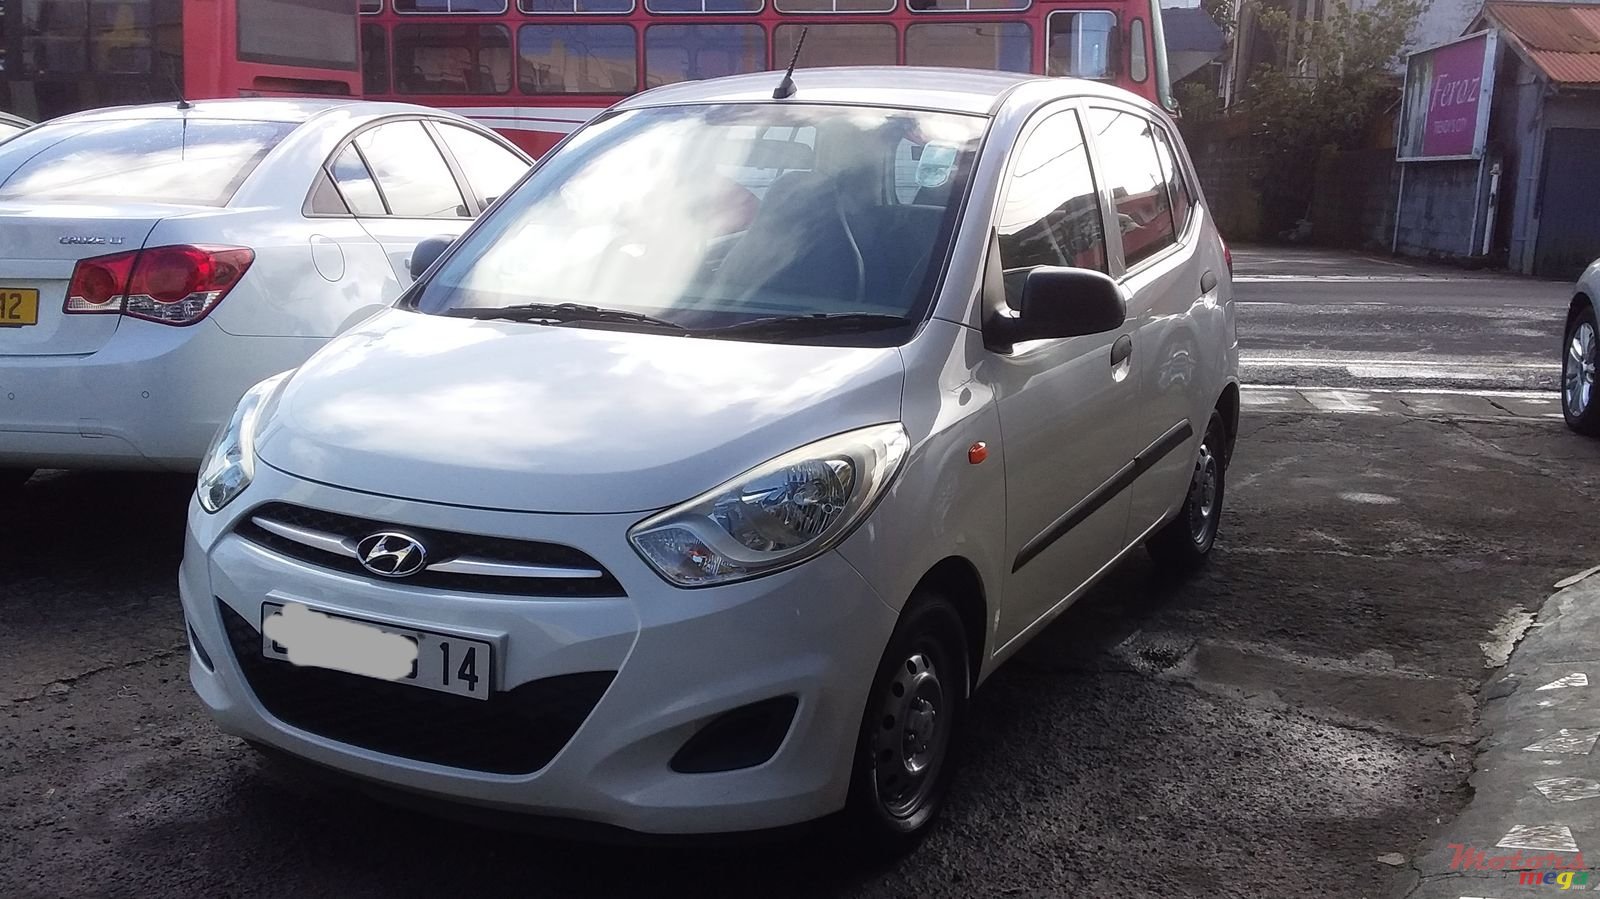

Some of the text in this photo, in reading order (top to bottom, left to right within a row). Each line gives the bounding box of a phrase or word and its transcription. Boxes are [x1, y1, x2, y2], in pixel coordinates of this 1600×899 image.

[1430, 73, 1480, 112] Feroz
[59, 236, 126, 244] CRUZE LT
[439, 642, 479, 692] 14
